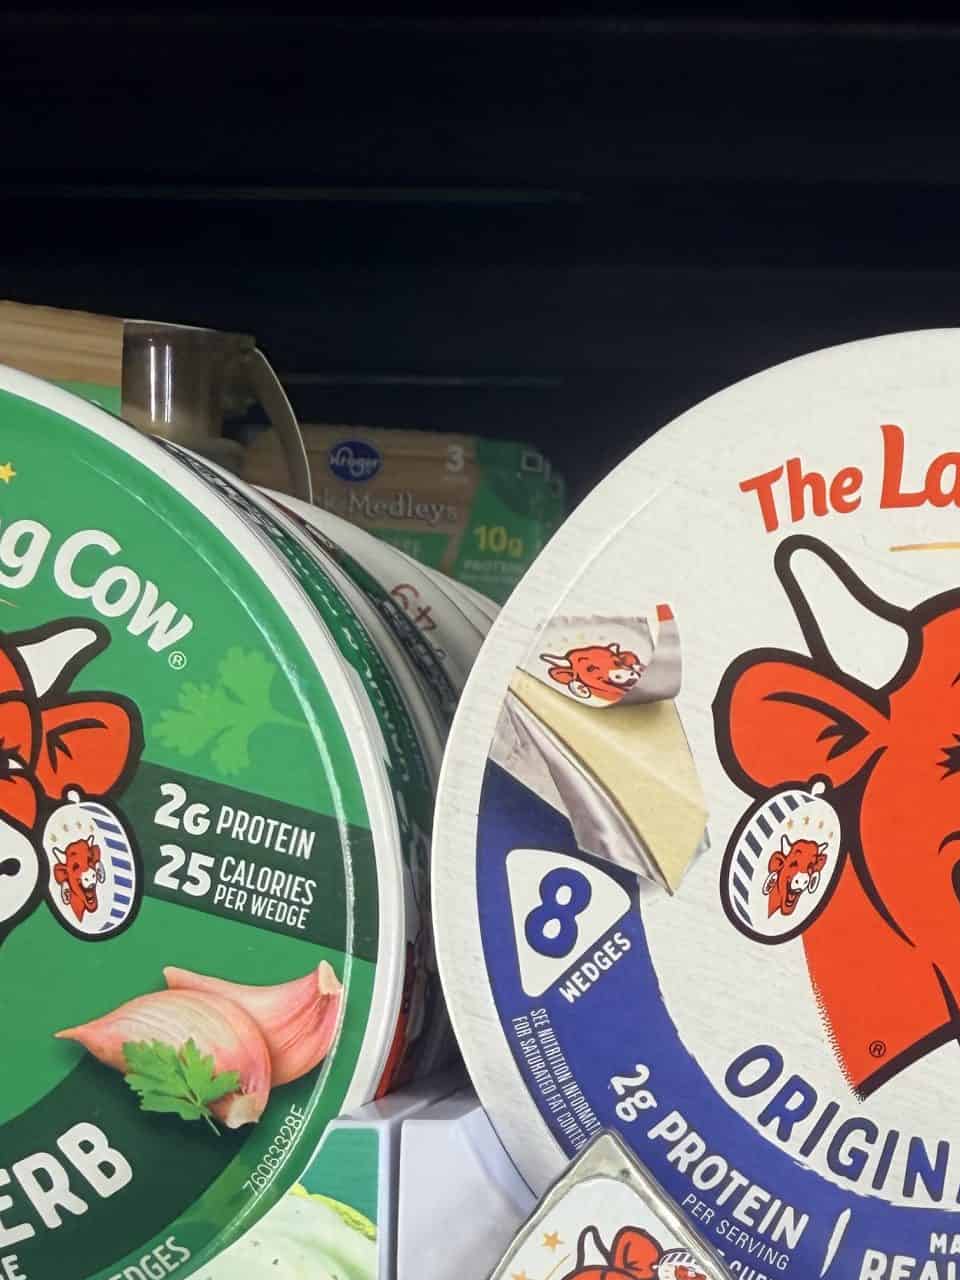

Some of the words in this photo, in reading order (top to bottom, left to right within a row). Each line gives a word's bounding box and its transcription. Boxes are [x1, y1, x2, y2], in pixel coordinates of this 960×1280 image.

[739, 457, 863, 533] The
[215, 806, 316, 860] PROTEIN
[153, 844, 215, 896] 25
[219, 856, 317, 905] CALORIES
[213, 886, 245, 912] PER
[250, 896, 310, 929] WEDGE
[524, 867, 592, 959] 8
[559, 932, 631, 1003] WEDGES
[511, 1016, 532, 1038] FOR
[530, 1008, 550, 1028] SEE
[520, 1037, 557, 1095] SATURATED
[538, 1027, 574, 1083] NUTRITION
[548, 1094, 568, 1113] FAT
[242, 1104, 305, 1196] 76063328F
[609, 1063, 658, 1122] 2g
[648, 1110, 810, 1250] PROTEIN
[681, 1193, 715, 1225] PER
[716, 1219, 790, 1271] SERVING
